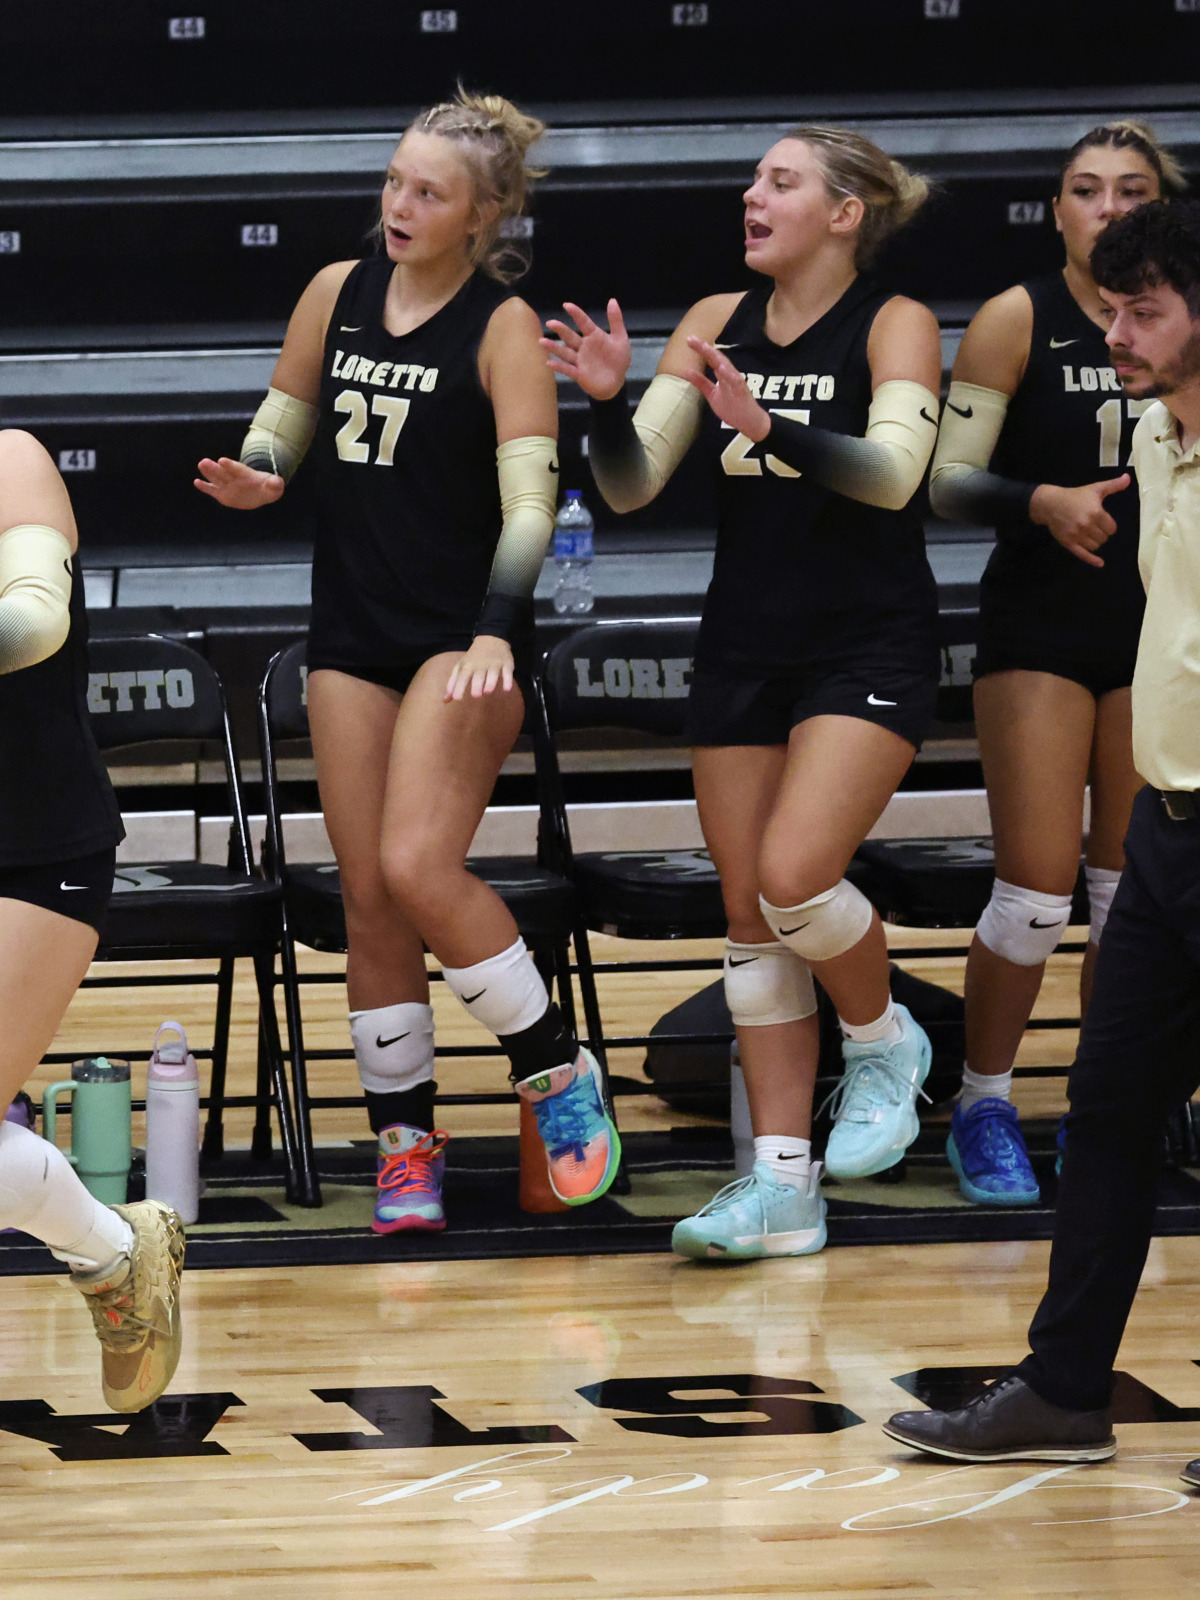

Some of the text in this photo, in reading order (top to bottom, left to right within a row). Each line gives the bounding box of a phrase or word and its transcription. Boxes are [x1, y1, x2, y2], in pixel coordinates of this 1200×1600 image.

[172, 17, 201, 38] 44
[1012, 202, 1041, 223] 47
[246, 225, 273, 245] 44
[331, 349, 439, 393] LORETTO
[1062, 365, 1124, 392] LOR
[738, 372, 835, 401] RETTO
[334, 389, 411, 466] 27
[65, 450, 92, 470] 41
[86, 668, 195, 713] ETTO
[573, 657, 695, 699] LORE
